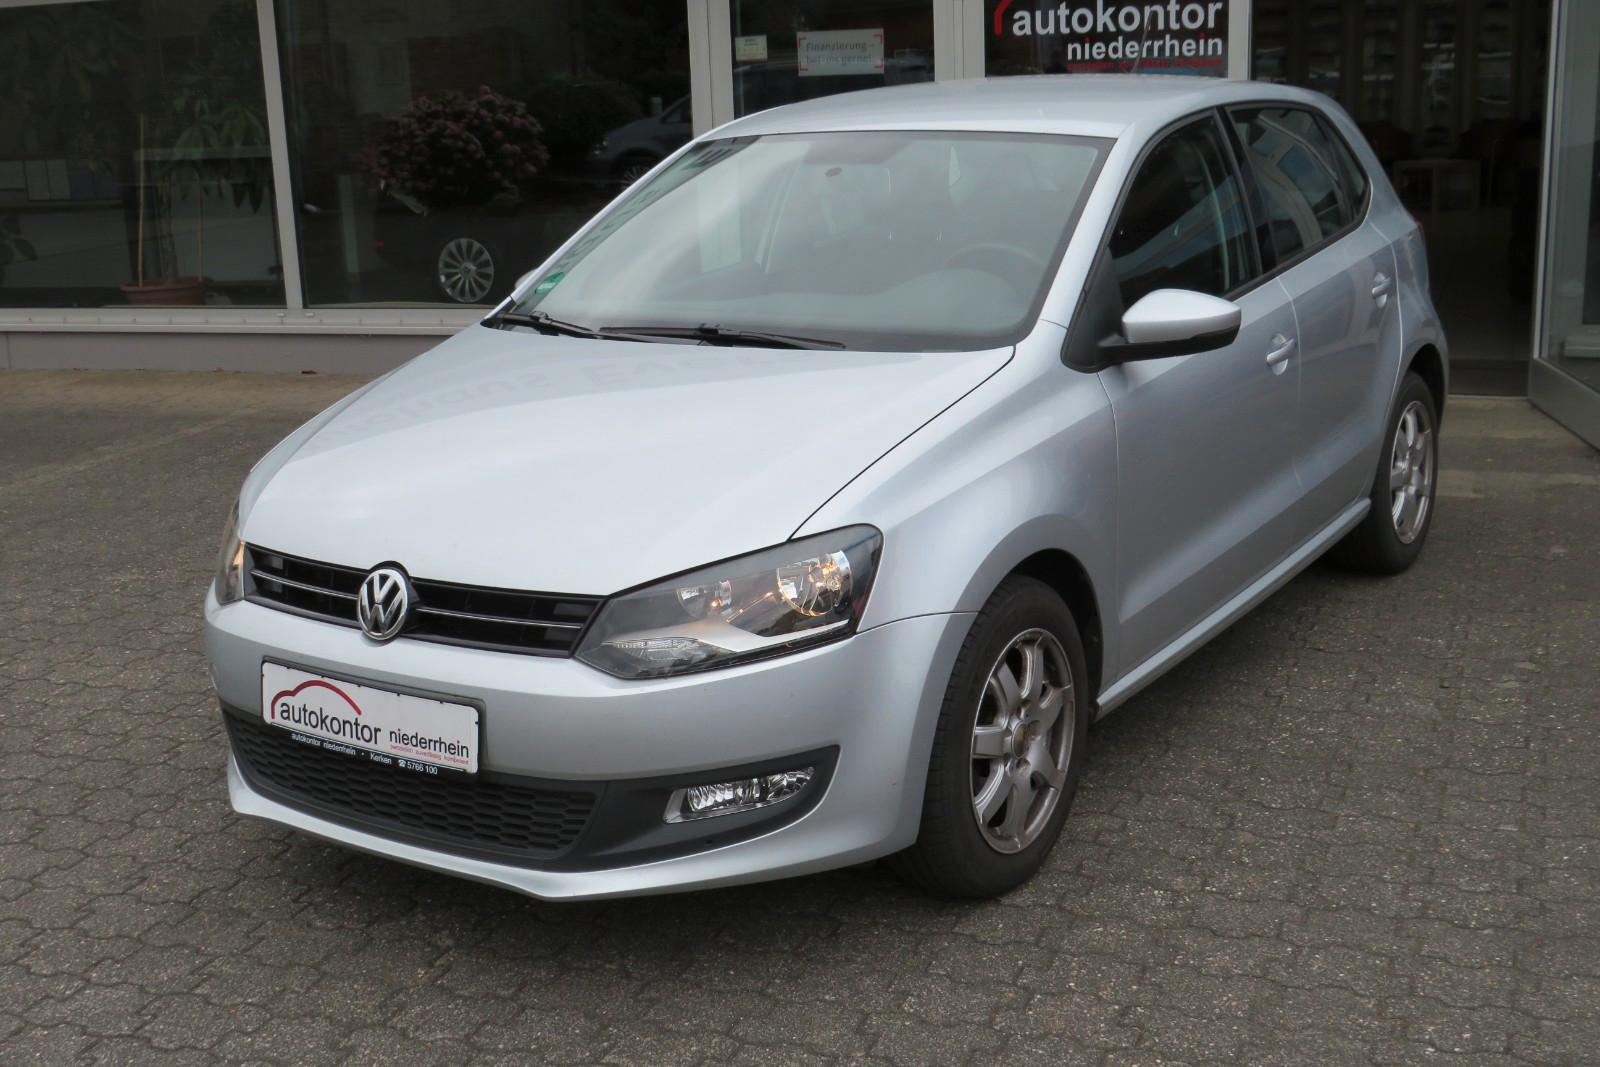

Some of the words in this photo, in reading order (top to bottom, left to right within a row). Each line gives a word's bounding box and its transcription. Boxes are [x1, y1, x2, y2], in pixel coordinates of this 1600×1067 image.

[1012, 0, 1223, 36] autokontor
[1067, 33, 1223, 61] niederrhein
[358, 568, 408, 640] VW
[280, 702, 382, 745] autokontor
[389, 727, 469, 758] niederrhein
[291, 733, 321, 747] autokontor
[323, 742, 356, 756] niederrhein
[370, 752, 392, 765] Kerken
[425, 764, 438, 775] 100
